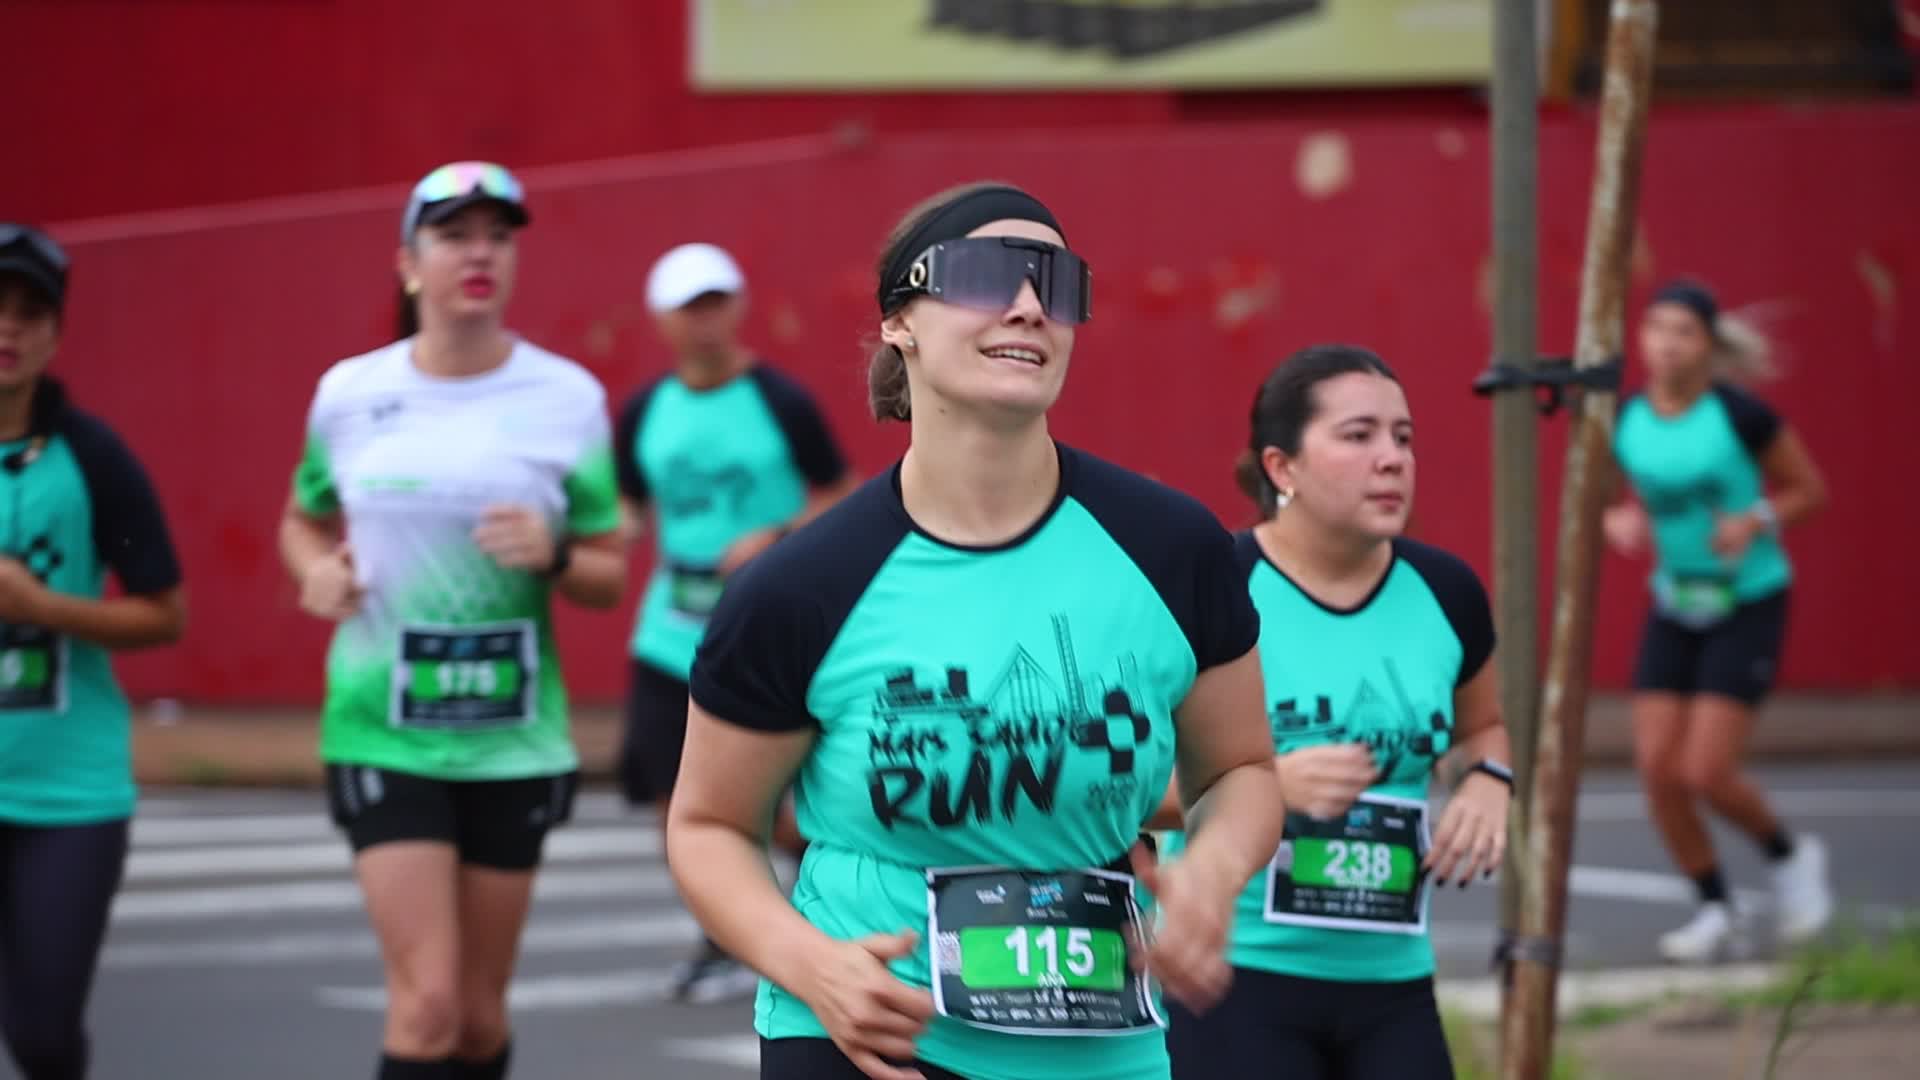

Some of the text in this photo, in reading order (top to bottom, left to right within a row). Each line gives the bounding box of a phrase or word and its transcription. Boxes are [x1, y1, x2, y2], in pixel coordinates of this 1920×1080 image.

[866, 746, 1066, 831] RUN
[1323, 839, 1393, 882] 238
[1005, 925, 1096, 977] 115
[1037, 971, 1068, 988] ANA
